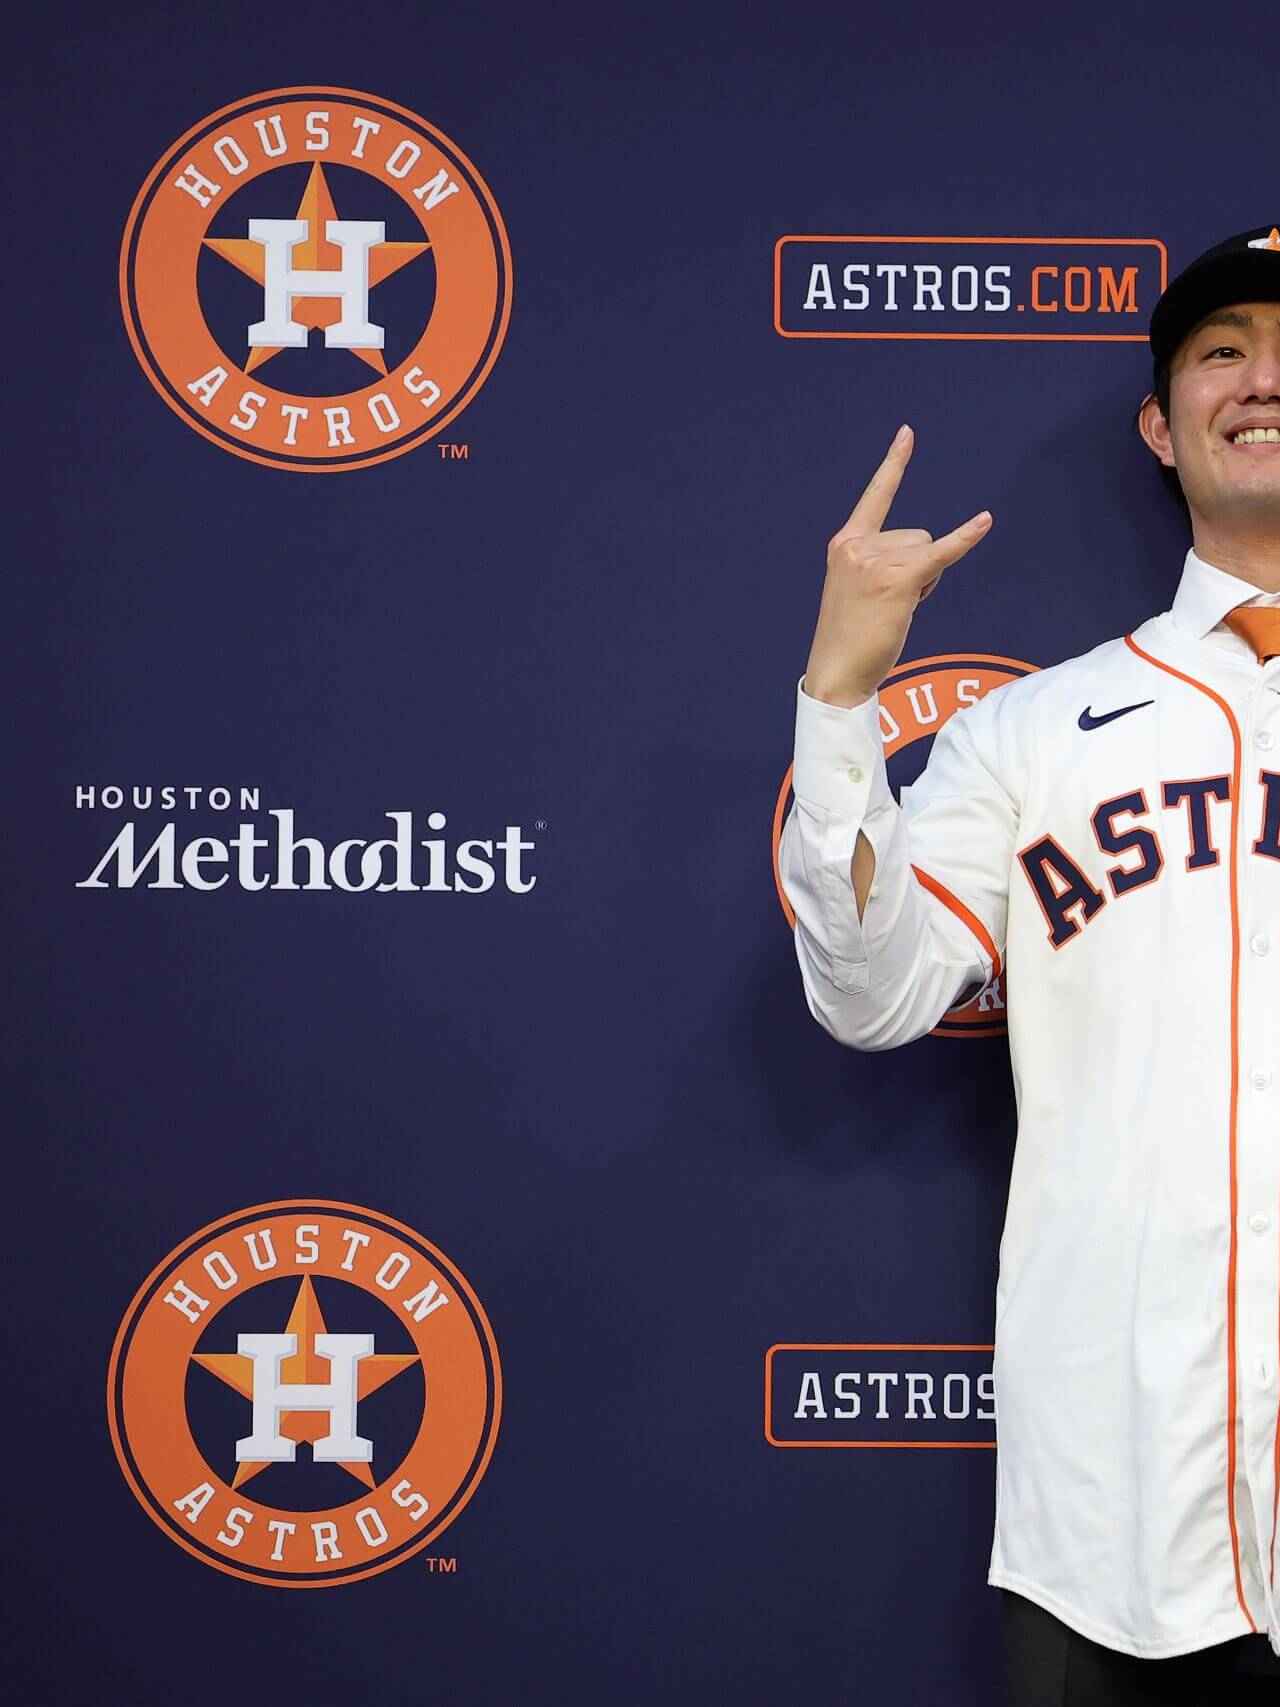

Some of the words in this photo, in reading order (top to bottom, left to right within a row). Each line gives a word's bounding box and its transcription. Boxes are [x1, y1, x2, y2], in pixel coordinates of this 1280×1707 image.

[174, 111, 460, 210] HOUSTON
[247, 218, 386, 350] H
[803, 263, 1139, 313] ASTROS.COM
[186, 365, 441, 447] ASTROS
[437, 444, 469, 459] TM
[75, 785, 260, 811] HOUSTON
[75, 808, 537, 894] Methodist
[163, 1224, 450, 1323] HOUSTON
[235, 1332, 375, 1463] H
[793, 1372, 997, 1420] ASTROS
[173, 1478, 430, 1562] ASTROS
[426, 1558, 457, 1573] TM
